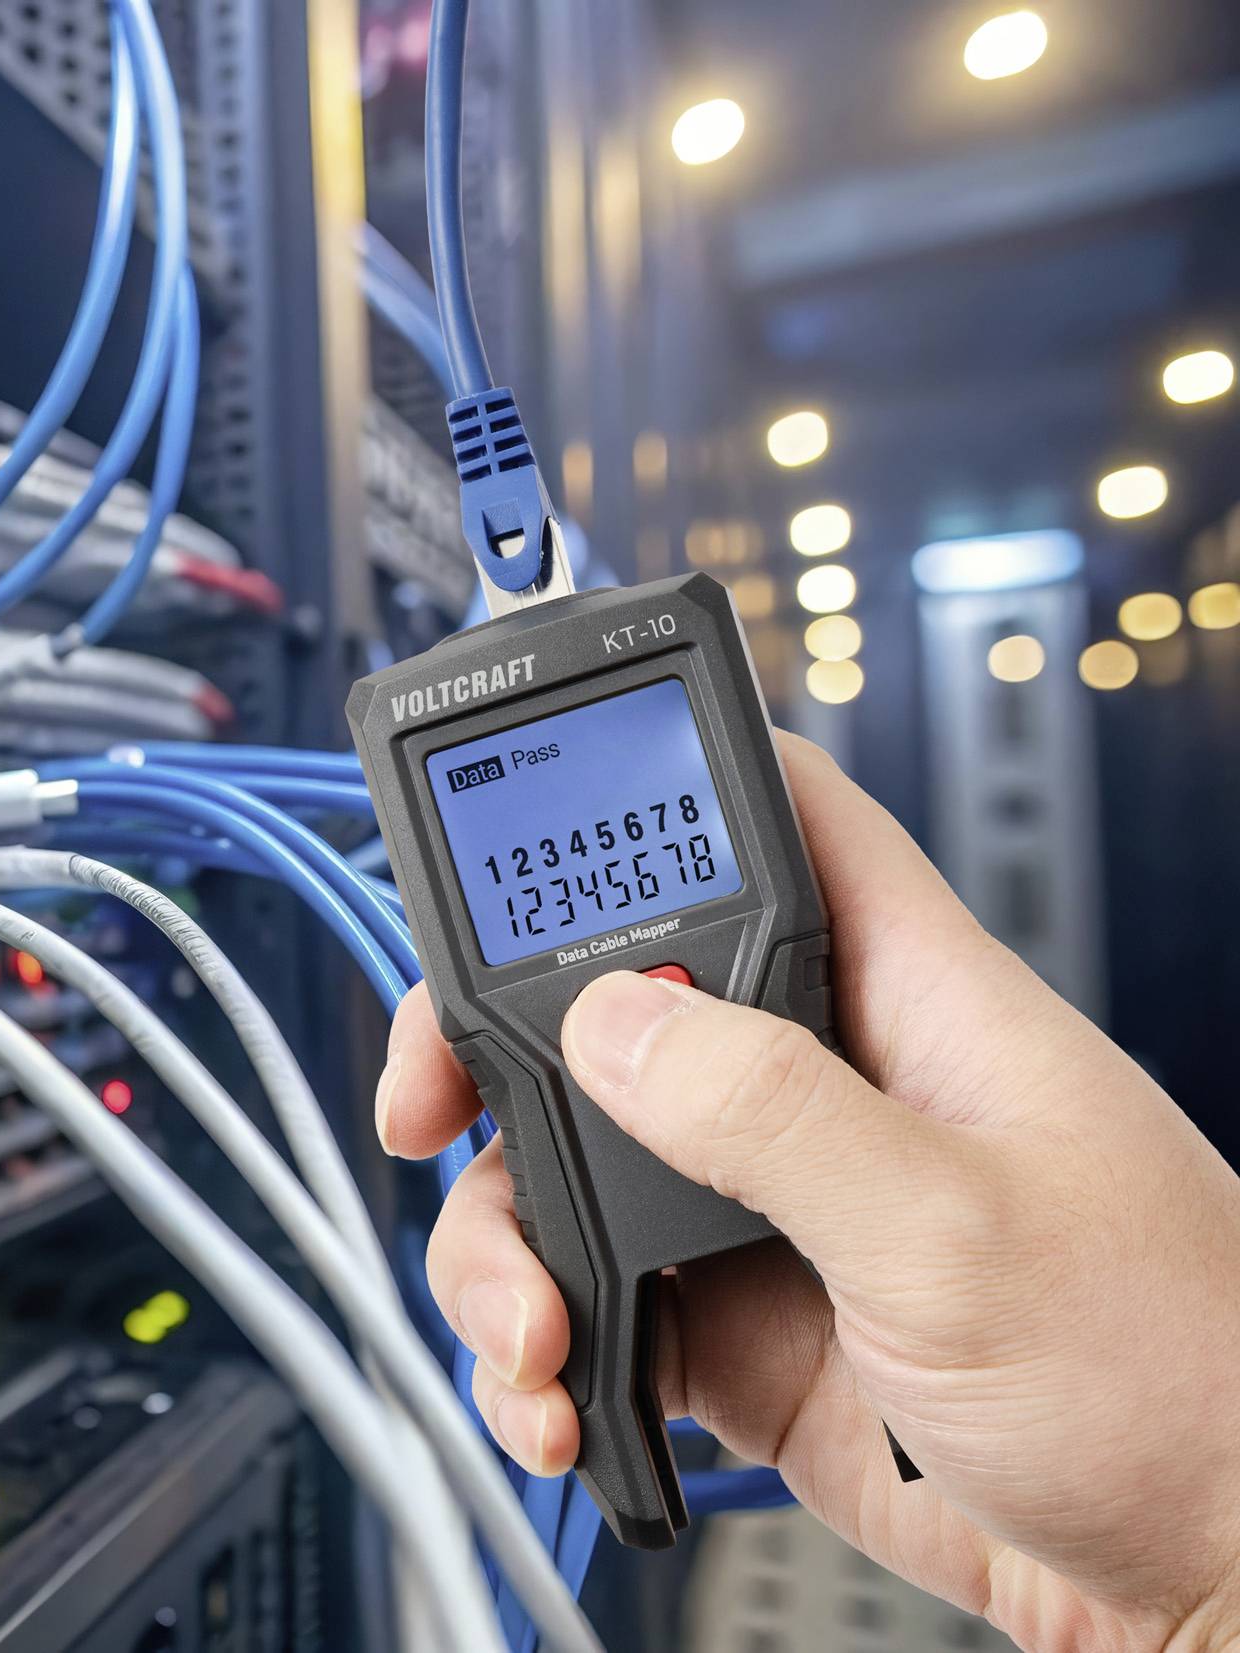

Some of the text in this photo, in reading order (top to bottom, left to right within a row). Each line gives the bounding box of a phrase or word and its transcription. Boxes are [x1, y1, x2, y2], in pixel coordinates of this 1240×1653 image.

[602, 614, 676, 654] KT-10
[390, 653, 536, 723] VOLTCRAFT
[450, 742, 561, 791] Data Pass
[556, 918, 681, 966] Data Cable Mapper
